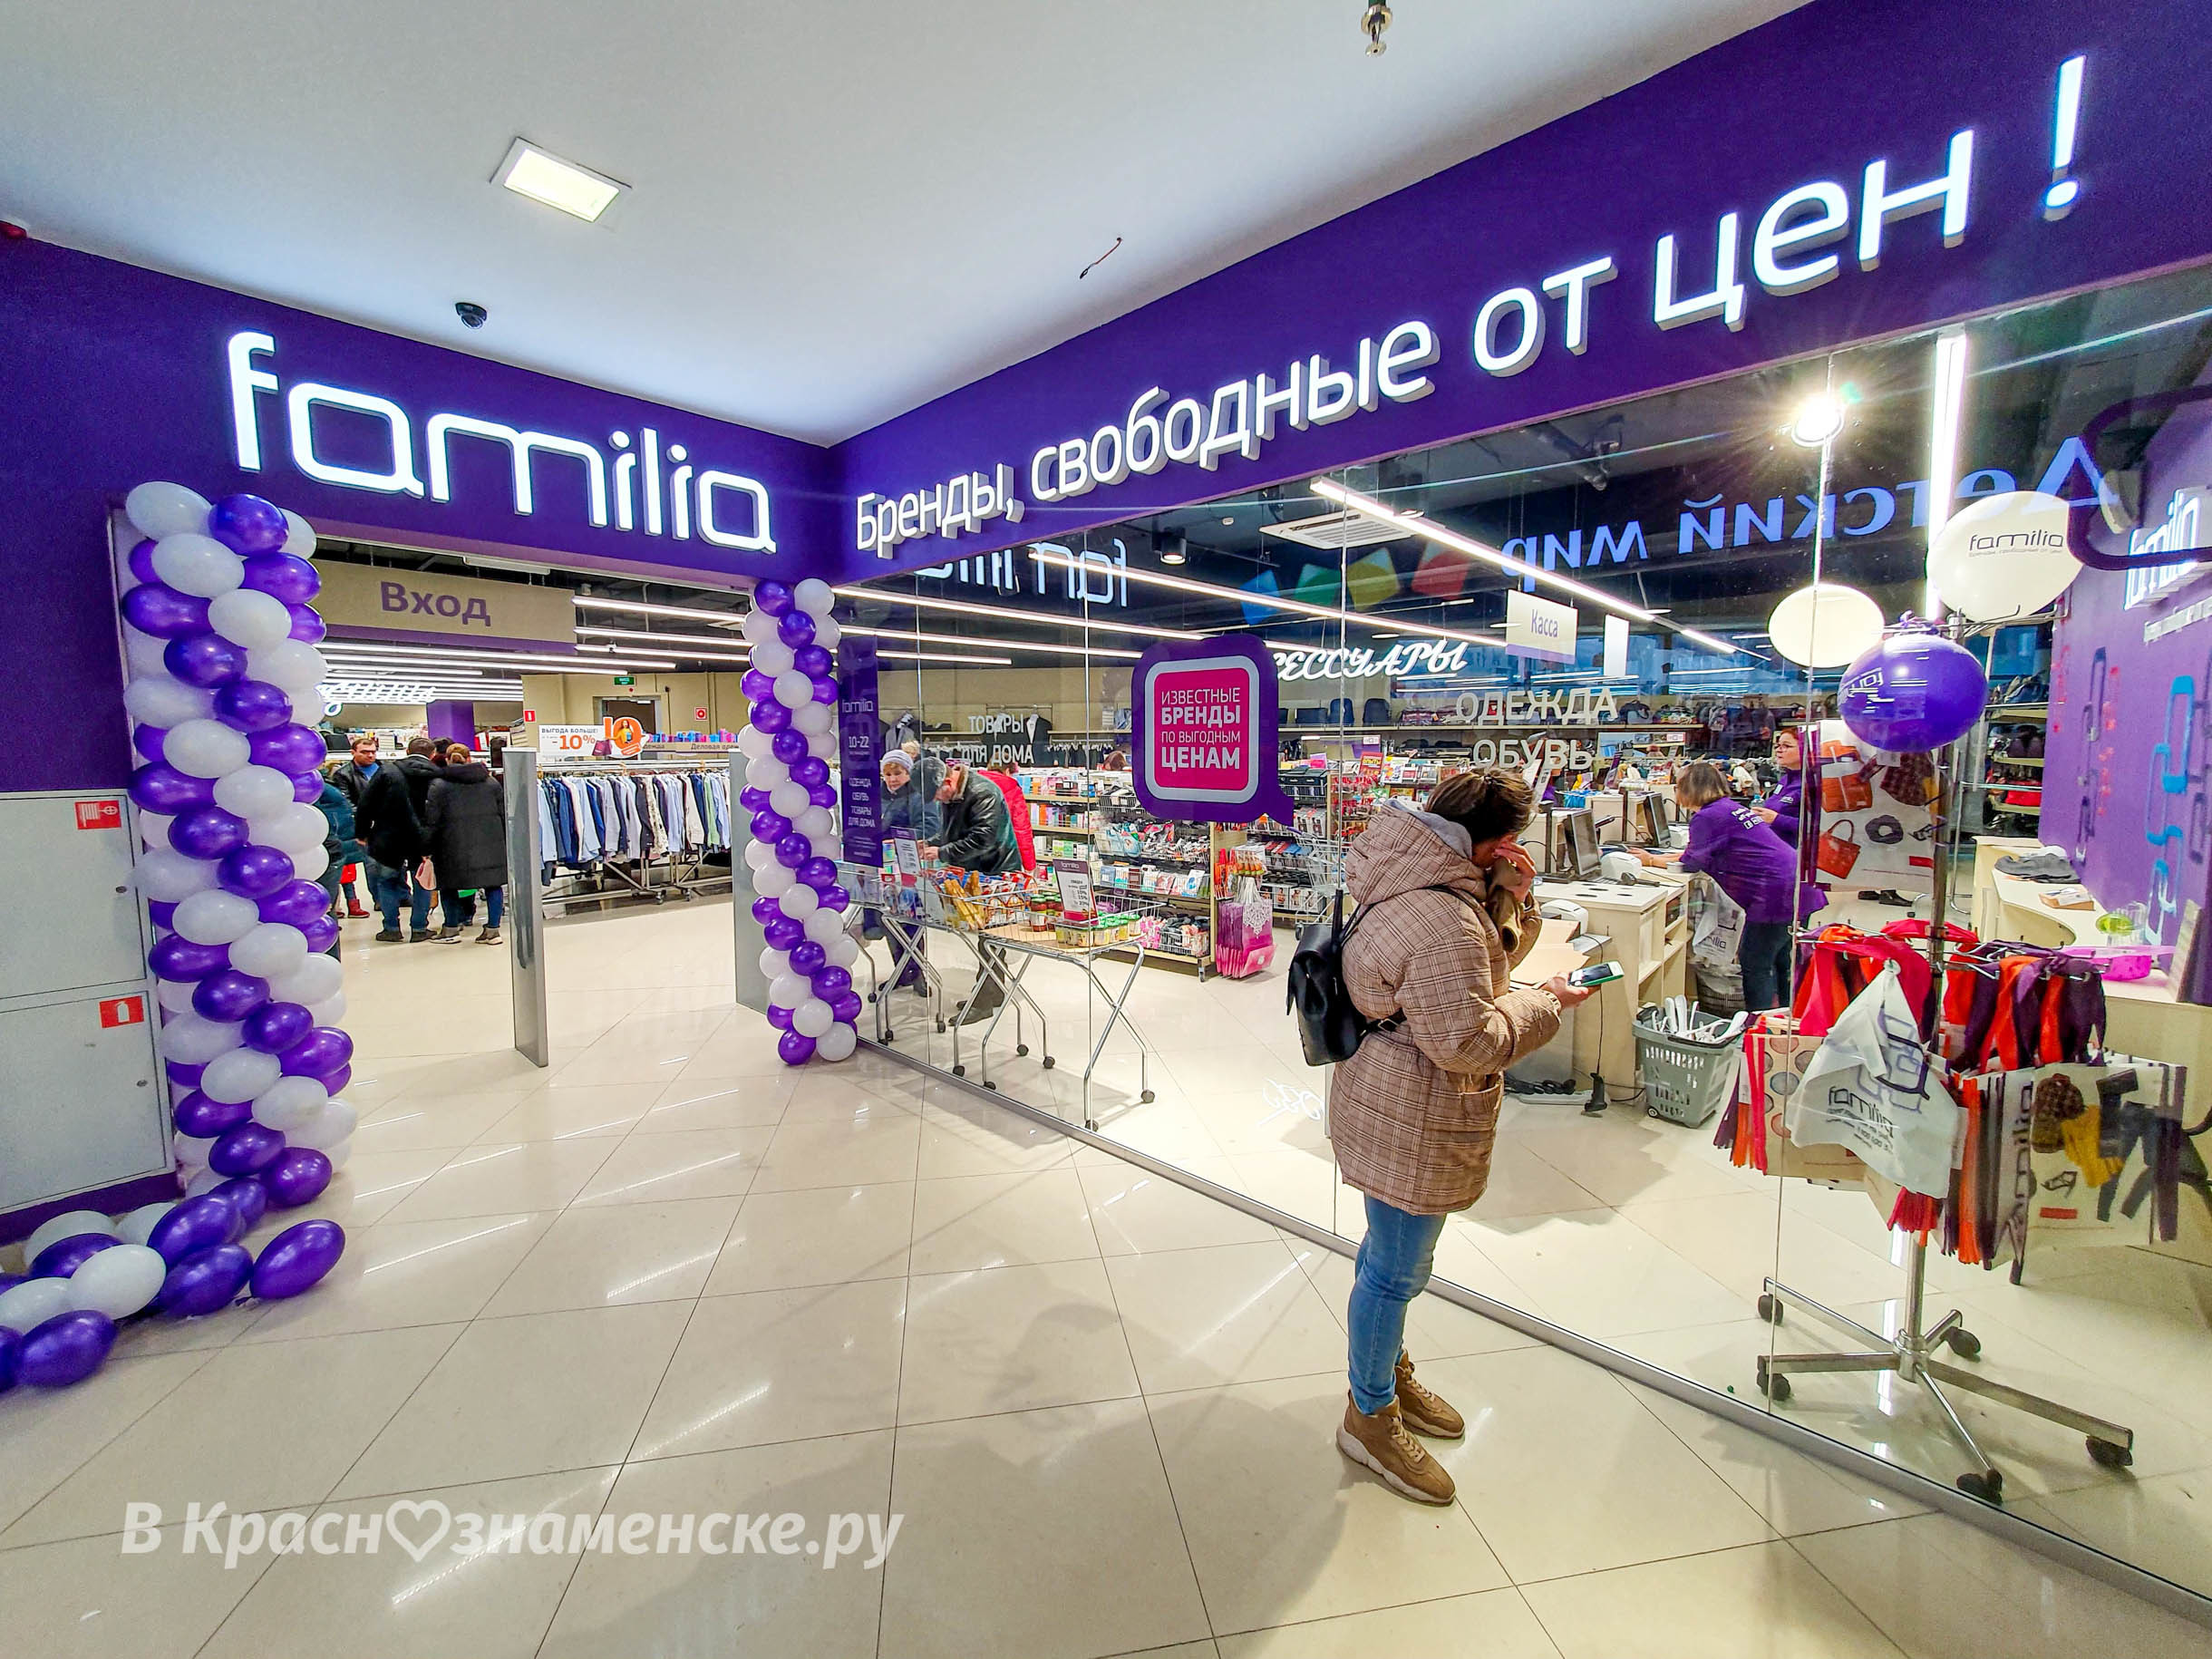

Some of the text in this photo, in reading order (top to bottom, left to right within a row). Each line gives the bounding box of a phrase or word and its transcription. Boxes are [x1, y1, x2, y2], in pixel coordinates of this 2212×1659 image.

[857, 461, 1026, 558] Бренды,
[1031, 320, 1440, 500] свободные
[1473, 256, 1618, 377] от
[1654, 129, 1974, 332] цен
[227, 332, 777, 554] familia
[1970, 529, 2063, 551] familia
[381, 581, 491, 627] Вход
[1530, 608, 1558, 637] Касса
[1161, 687, 1241, 705] ИЗВЕСТНЫЕ
[1456, 687, 1618, 726] ОДЕЖДА
[968, 713, 1024, 733] ТОВАРЫ
[1161, 705, 1241, 729] БРЕНДЫ
[1161, 731, 1241, 745] ПО ВЫГОДНЫМ
[991, 744, 1034, 767] ДОМА
[1161, 746, 1241, 773] ЦЕНАМ
[1472, 738, 1593, 771] ОБУВЬ
